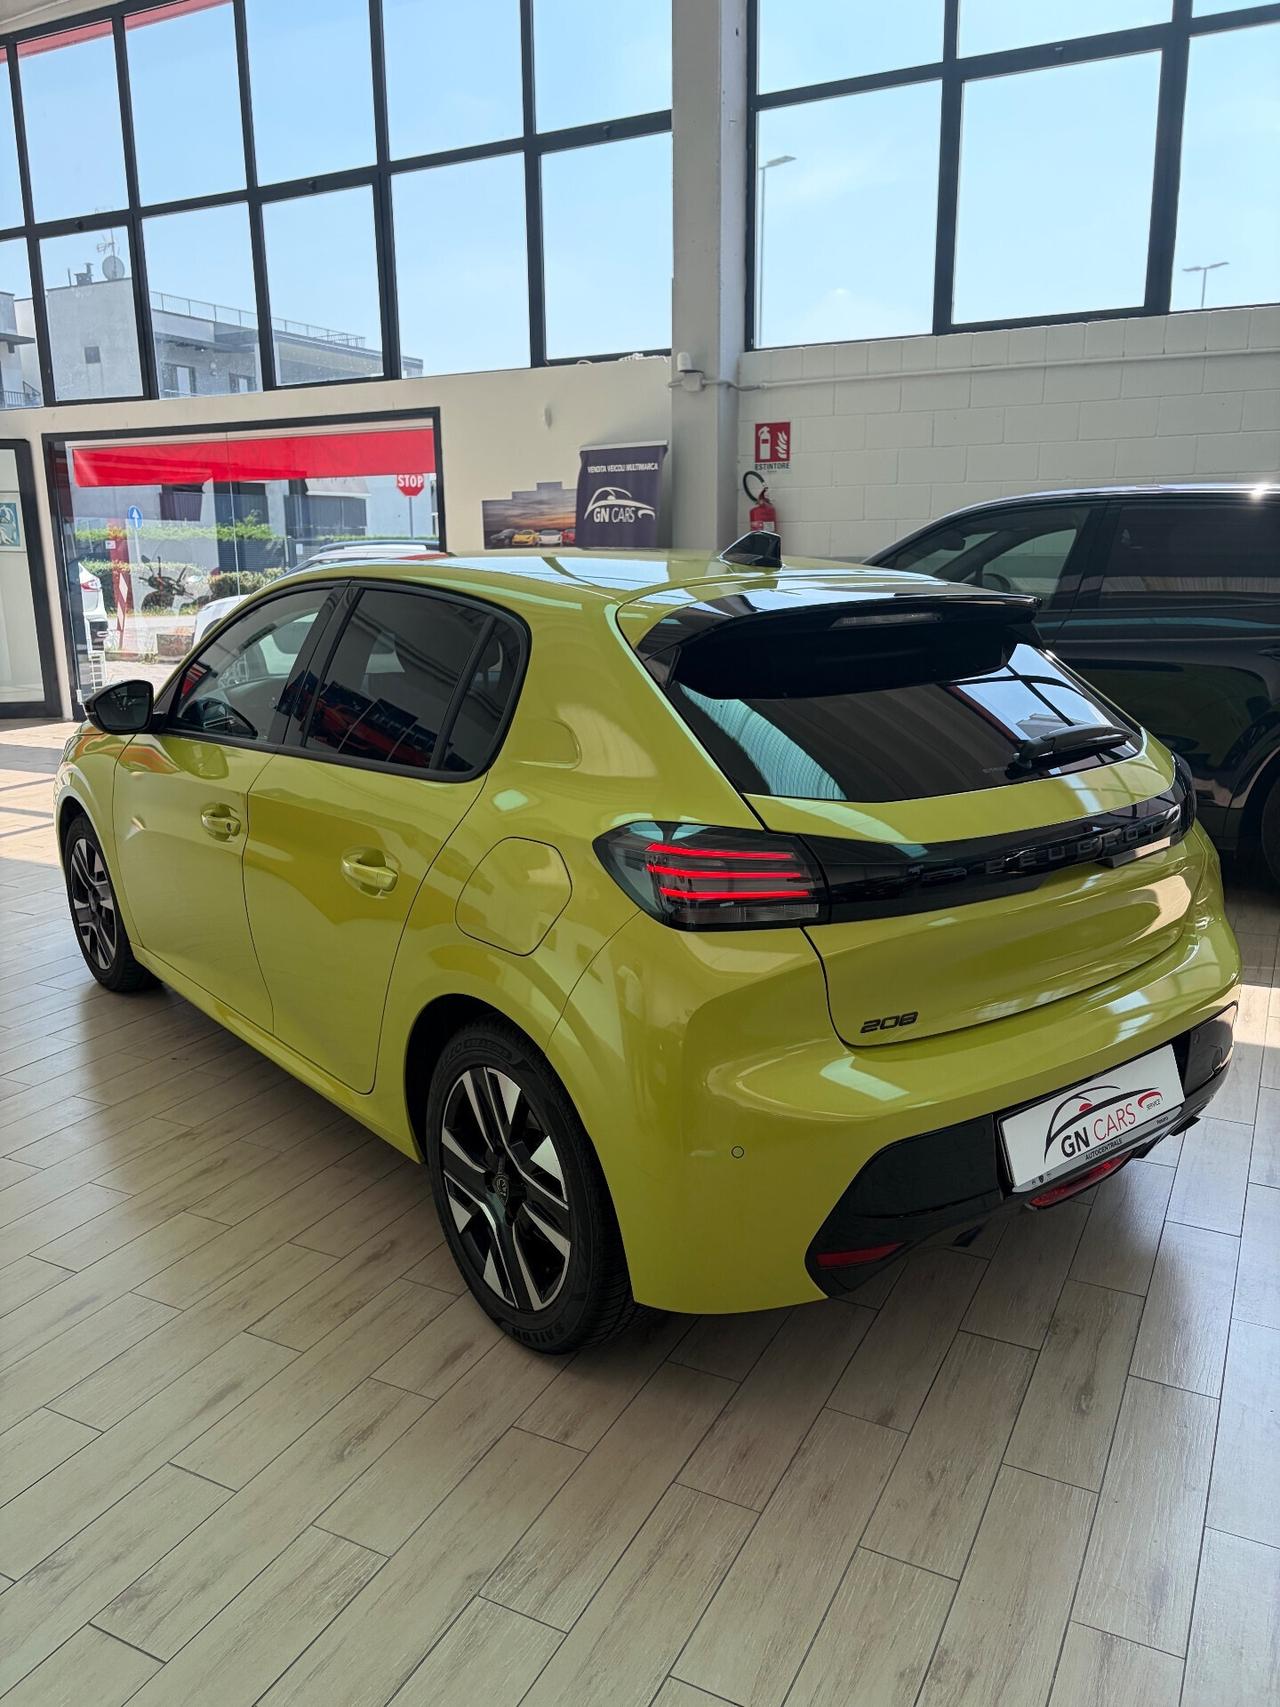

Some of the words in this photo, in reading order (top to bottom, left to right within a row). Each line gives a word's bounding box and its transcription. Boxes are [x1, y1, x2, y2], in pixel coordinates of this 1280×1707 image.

[587, 465, 607, 473] VENDITA
[626, 462, 658, 471] MULTIMARCA
[755, 462, 790, 471] ESTINTORE
[398, 474, 424, 487] STOP
[593, 507, 609, 522] GN
[611, 507, 635, 522] CARS
[984, 821, 1159, 874] PEUGEOT
[861, 1011, 918, 1034] 208
[1061, 1127, 1090, 1157] GN
[1093, 1103, 1136, 1141] CARS
[1085, 1138, 1123, 1161] AUTOCENTRALE
